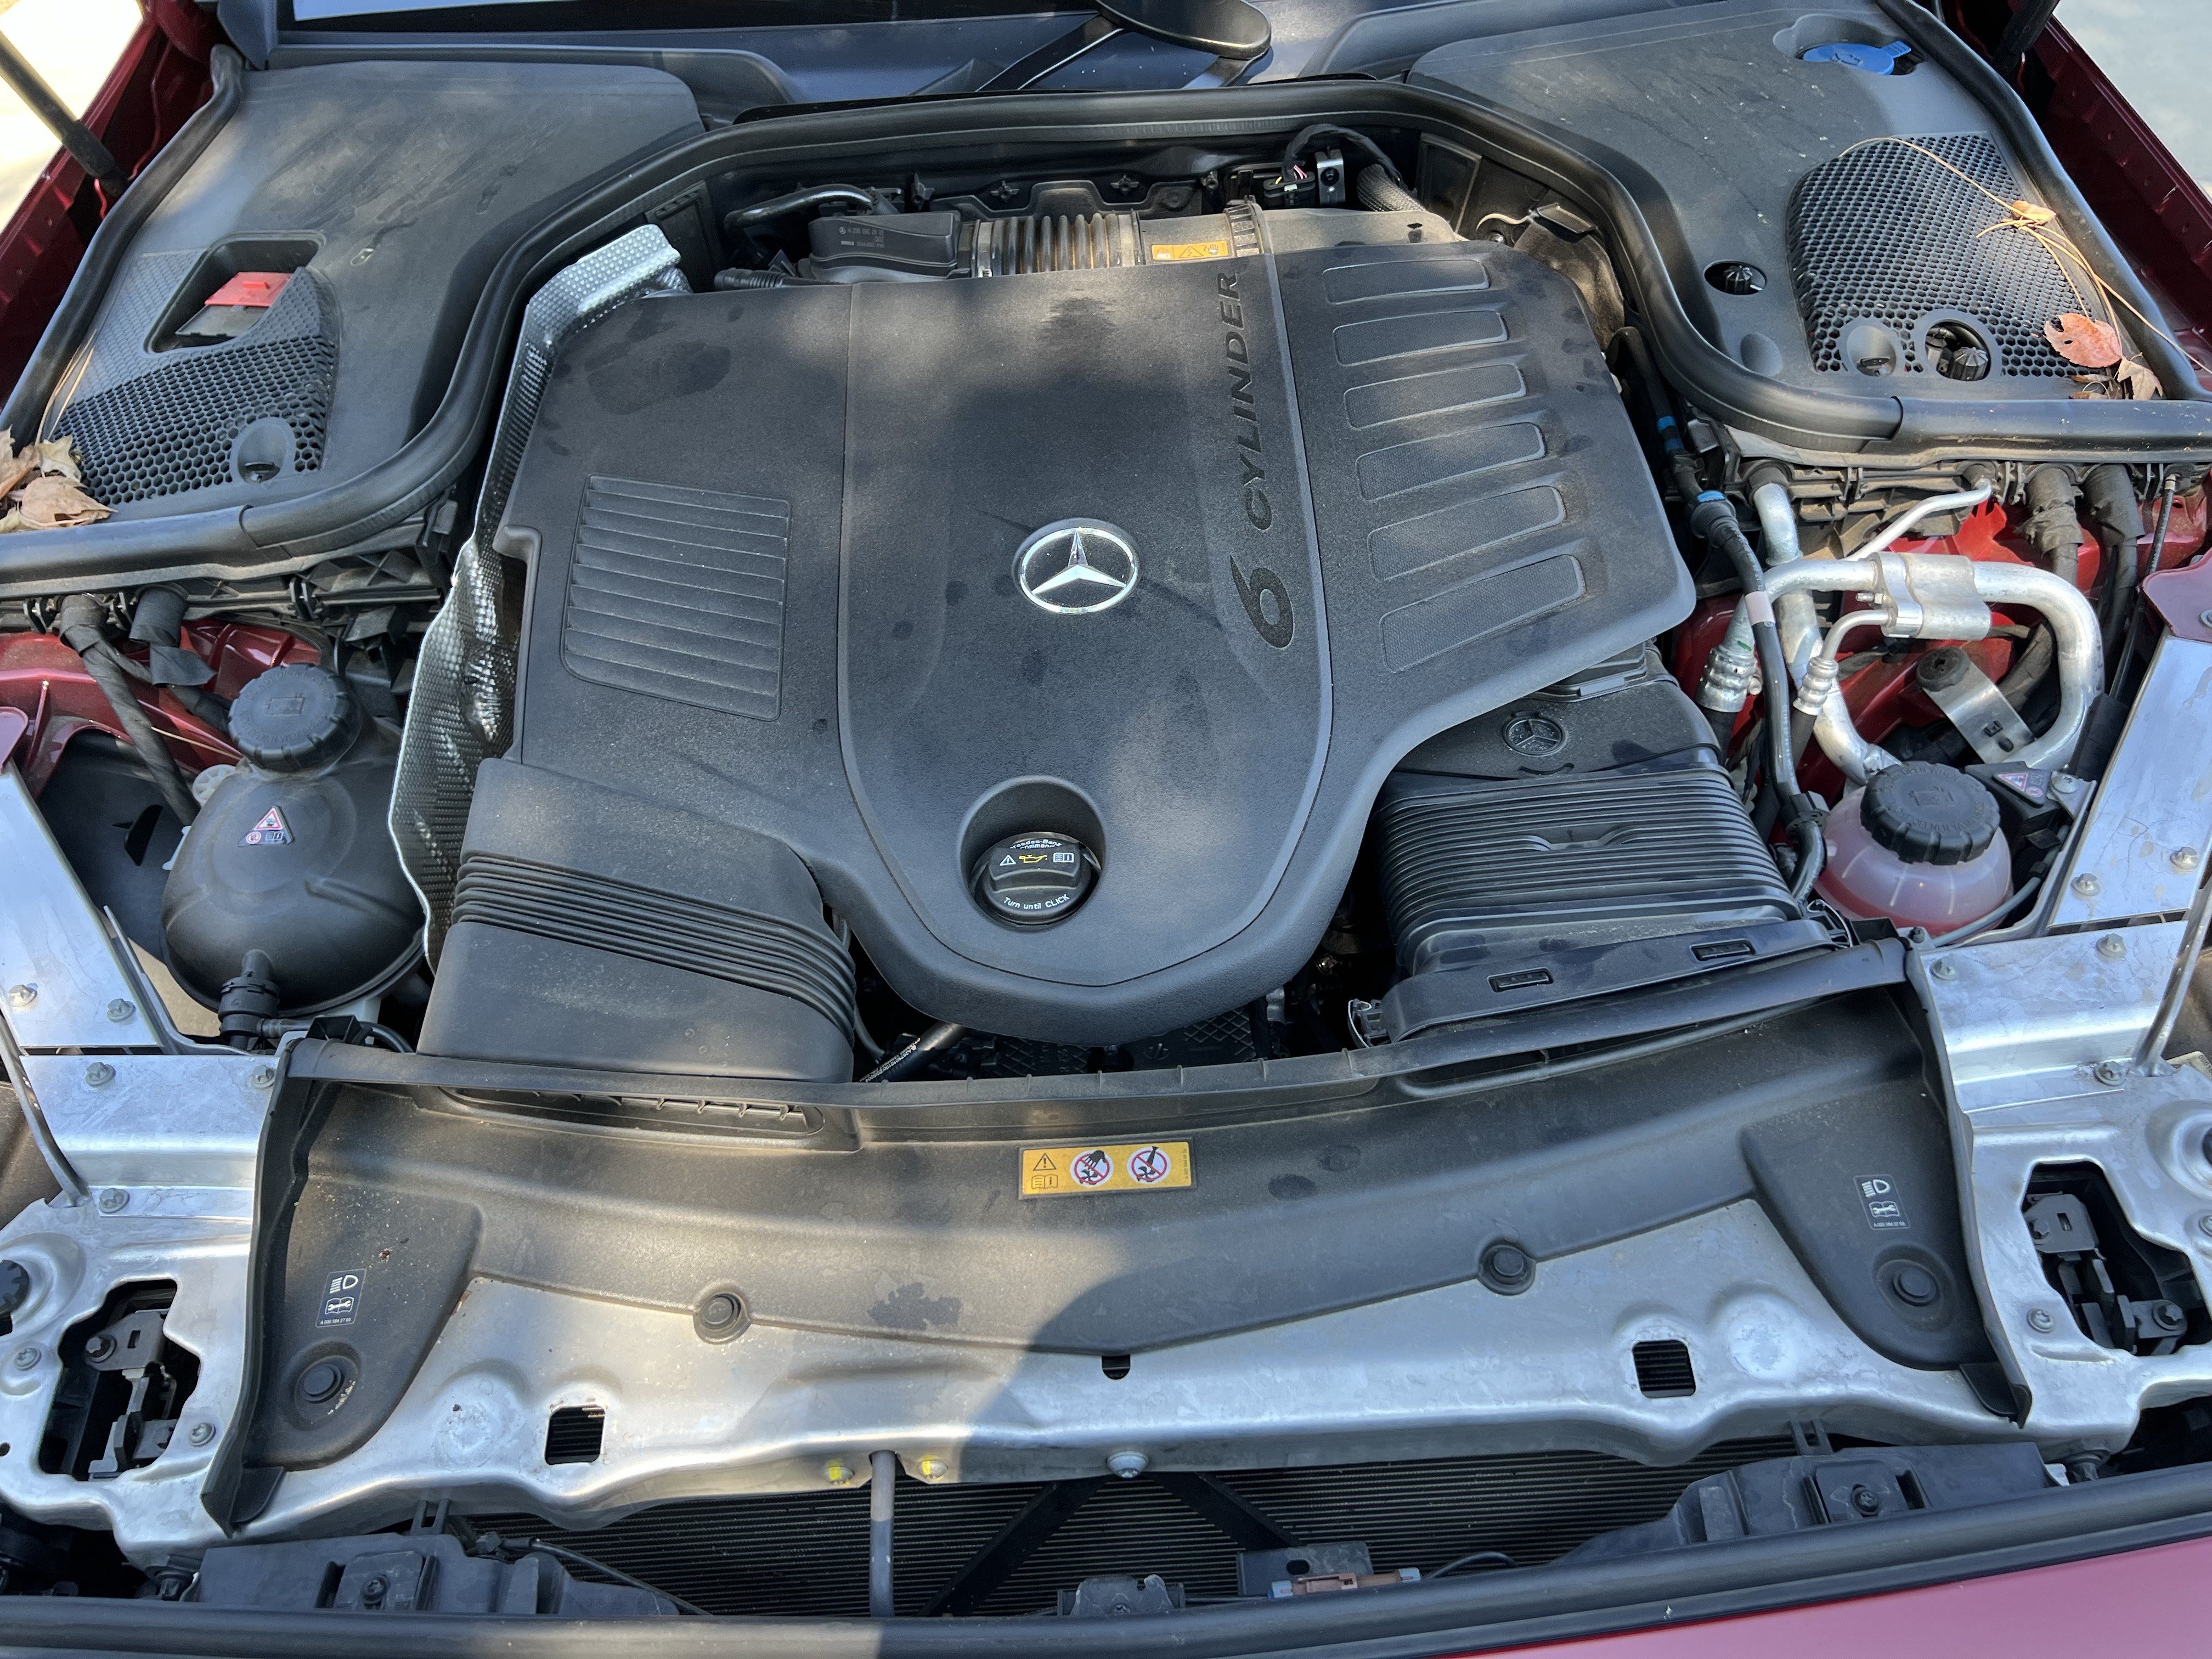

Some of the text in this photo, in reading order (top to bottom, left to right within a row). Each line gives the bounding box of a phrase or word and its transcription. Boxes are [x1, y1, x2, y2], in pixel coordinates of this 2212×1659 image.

[1217, 272, 1295, 650] 6 CYLINDER
[1003, 896, 1020, 908] Turn
[1045, 894, 1070, 907] CLICK
